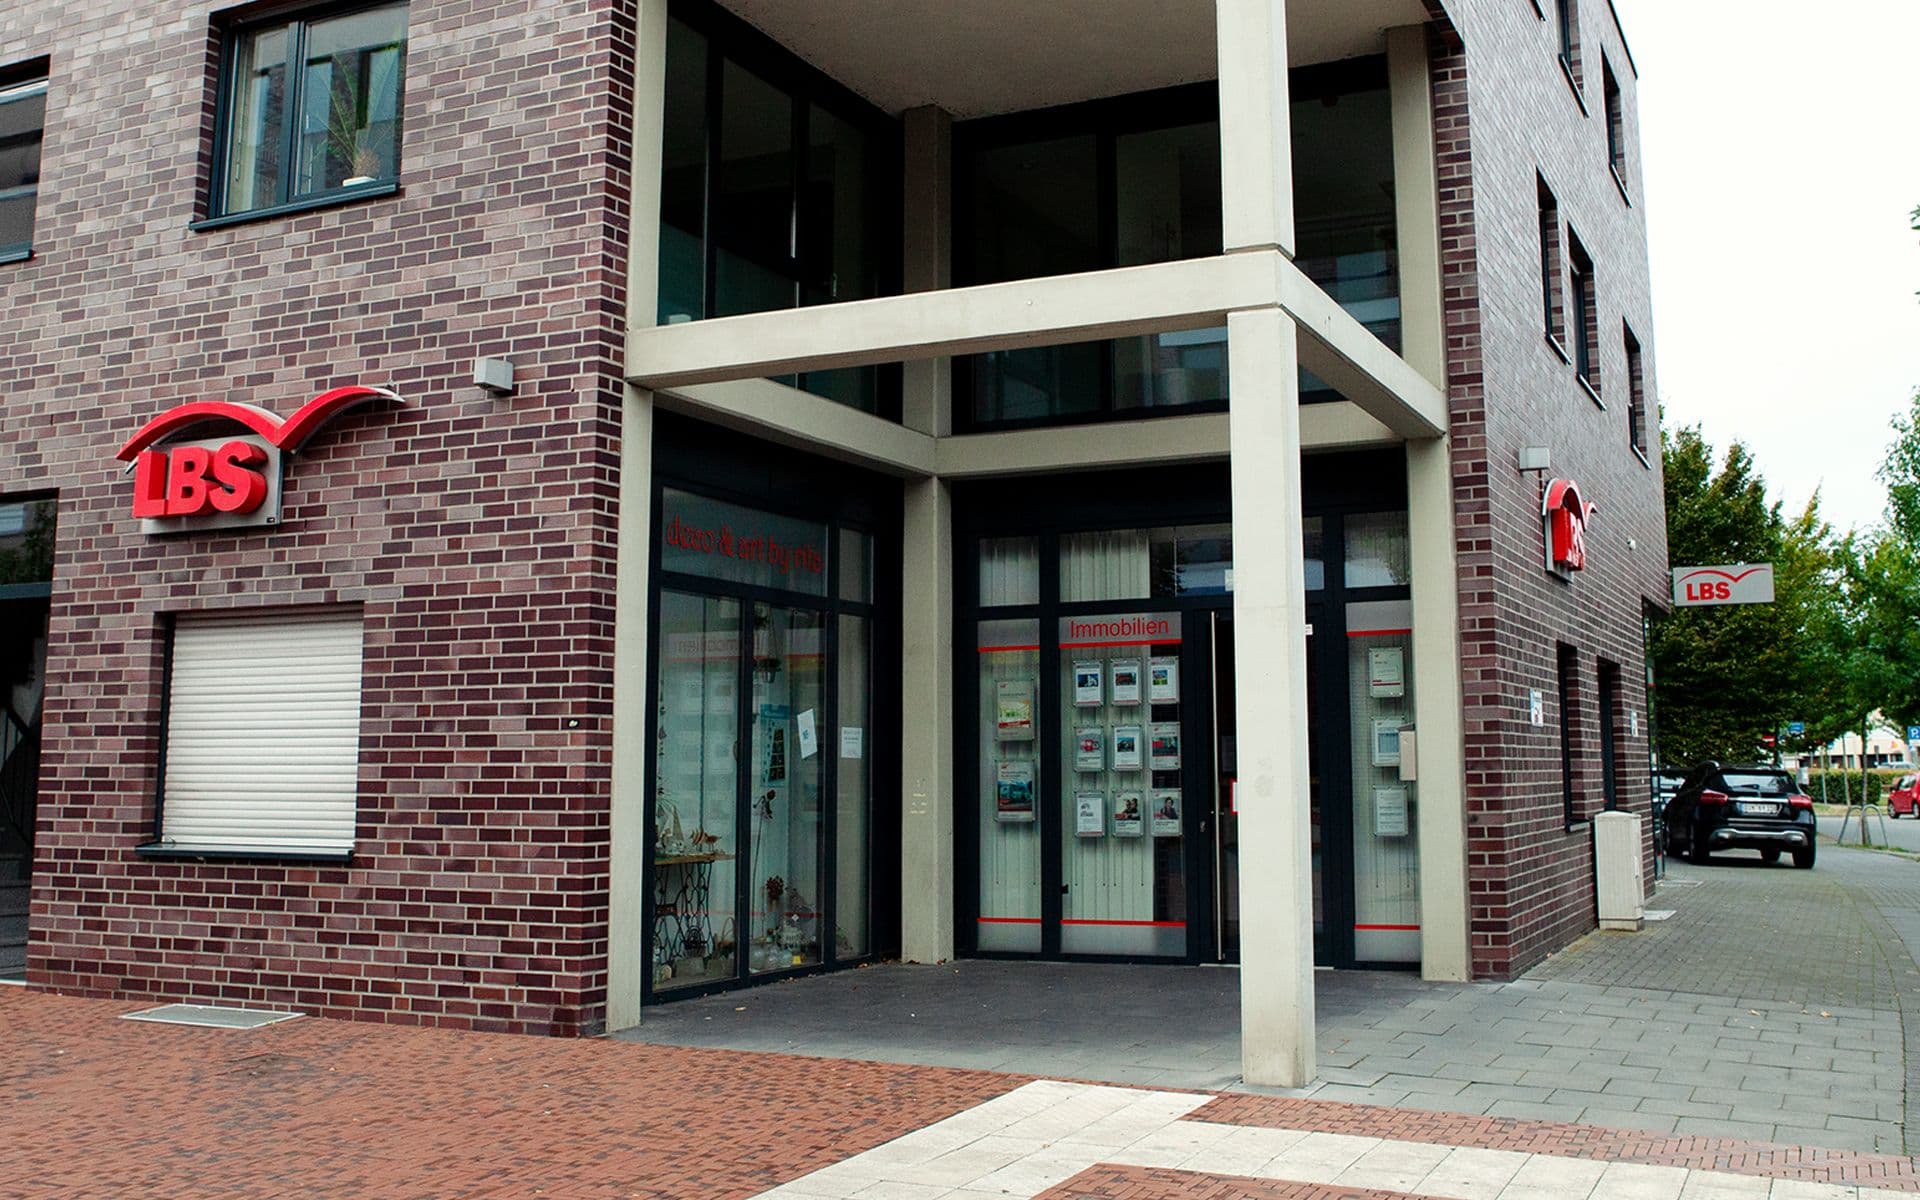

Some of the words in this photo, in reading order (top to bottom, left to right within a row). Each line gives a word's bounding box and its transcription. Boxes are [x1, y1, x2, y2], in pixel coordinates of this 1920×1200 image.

[131, 441, 268, 518] LBS
[716, 523, 735, 557] &
[738, 534, 764, 560] art
[768, 535, 789, 574] by
[1686, 582, 1731, 601] LBS
[1069, 617, 1169, 639] Immobilien
